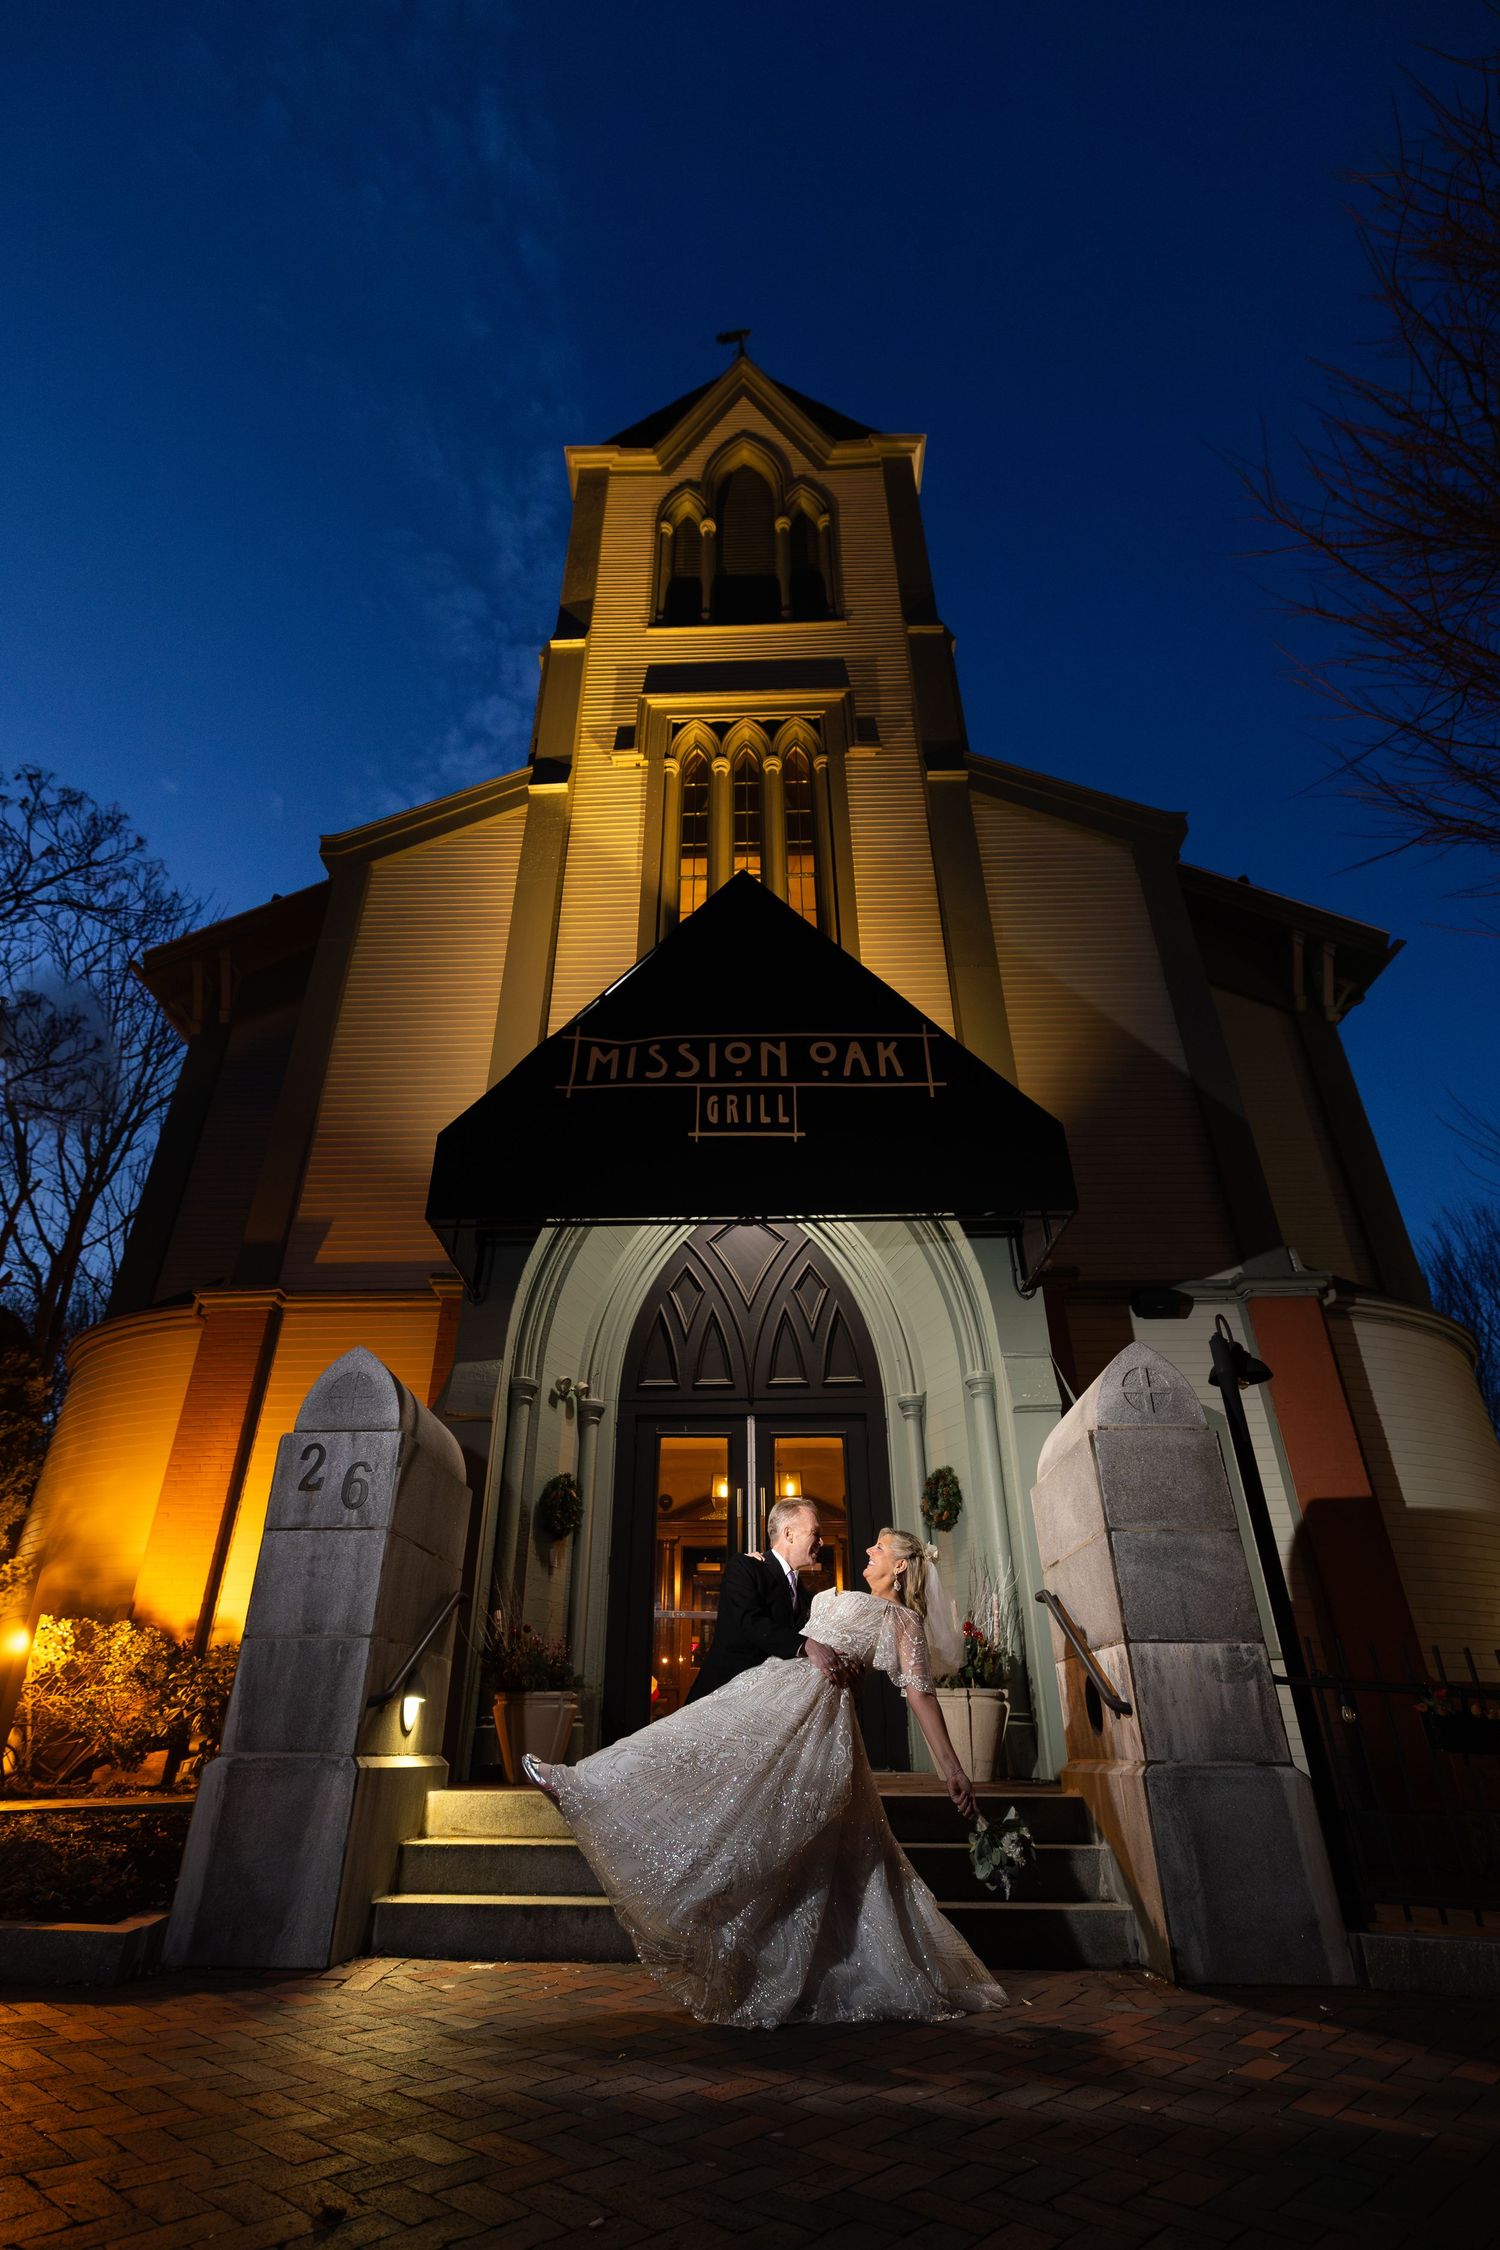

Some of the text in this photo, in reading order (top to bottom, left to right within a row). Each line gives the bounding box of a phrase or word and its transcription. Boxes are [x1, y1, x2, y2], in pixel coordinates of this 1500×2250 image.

[586, 1041, 905, 1081] MISSION OAK
[706, 1094, 790, 1124] GRILL
[298, 1442, 373, 1510] 26
